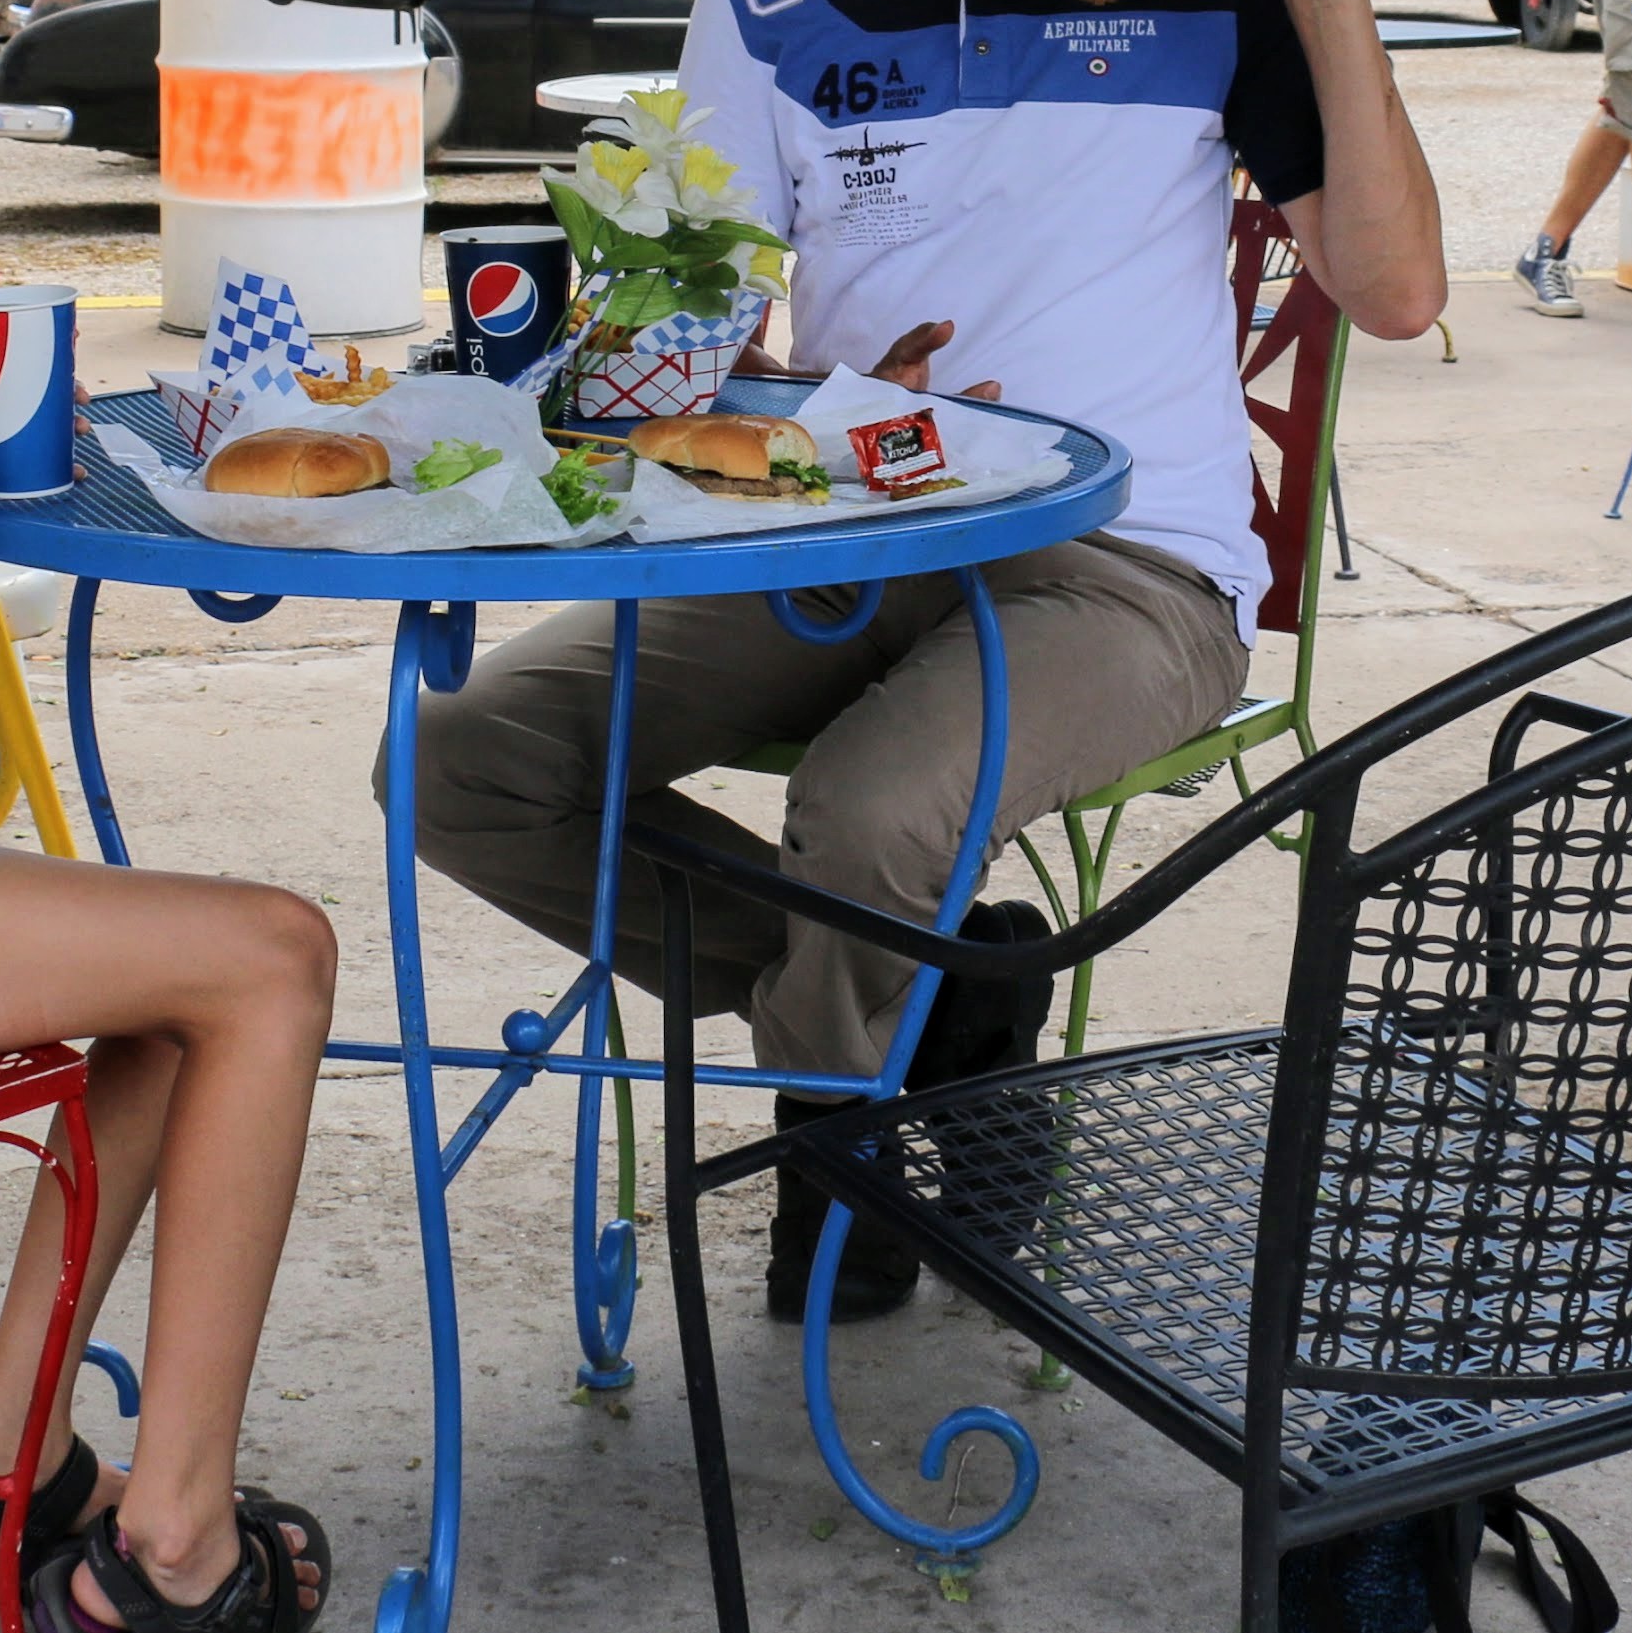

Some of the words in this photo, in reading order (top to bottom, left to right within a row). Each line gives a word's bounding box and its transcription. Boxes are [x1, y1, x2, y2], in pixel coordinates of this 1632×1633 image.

[1043, 18, 1157, 40] AERONAUTICA
[1068, 38, 1131, 53] MILITARE
[812, 61, 879, 119] 46
[843, 167, 896, 190] C-130J
[466, 337, 490, 376] psi
[888, 443, 919, 459] KETCHUP
